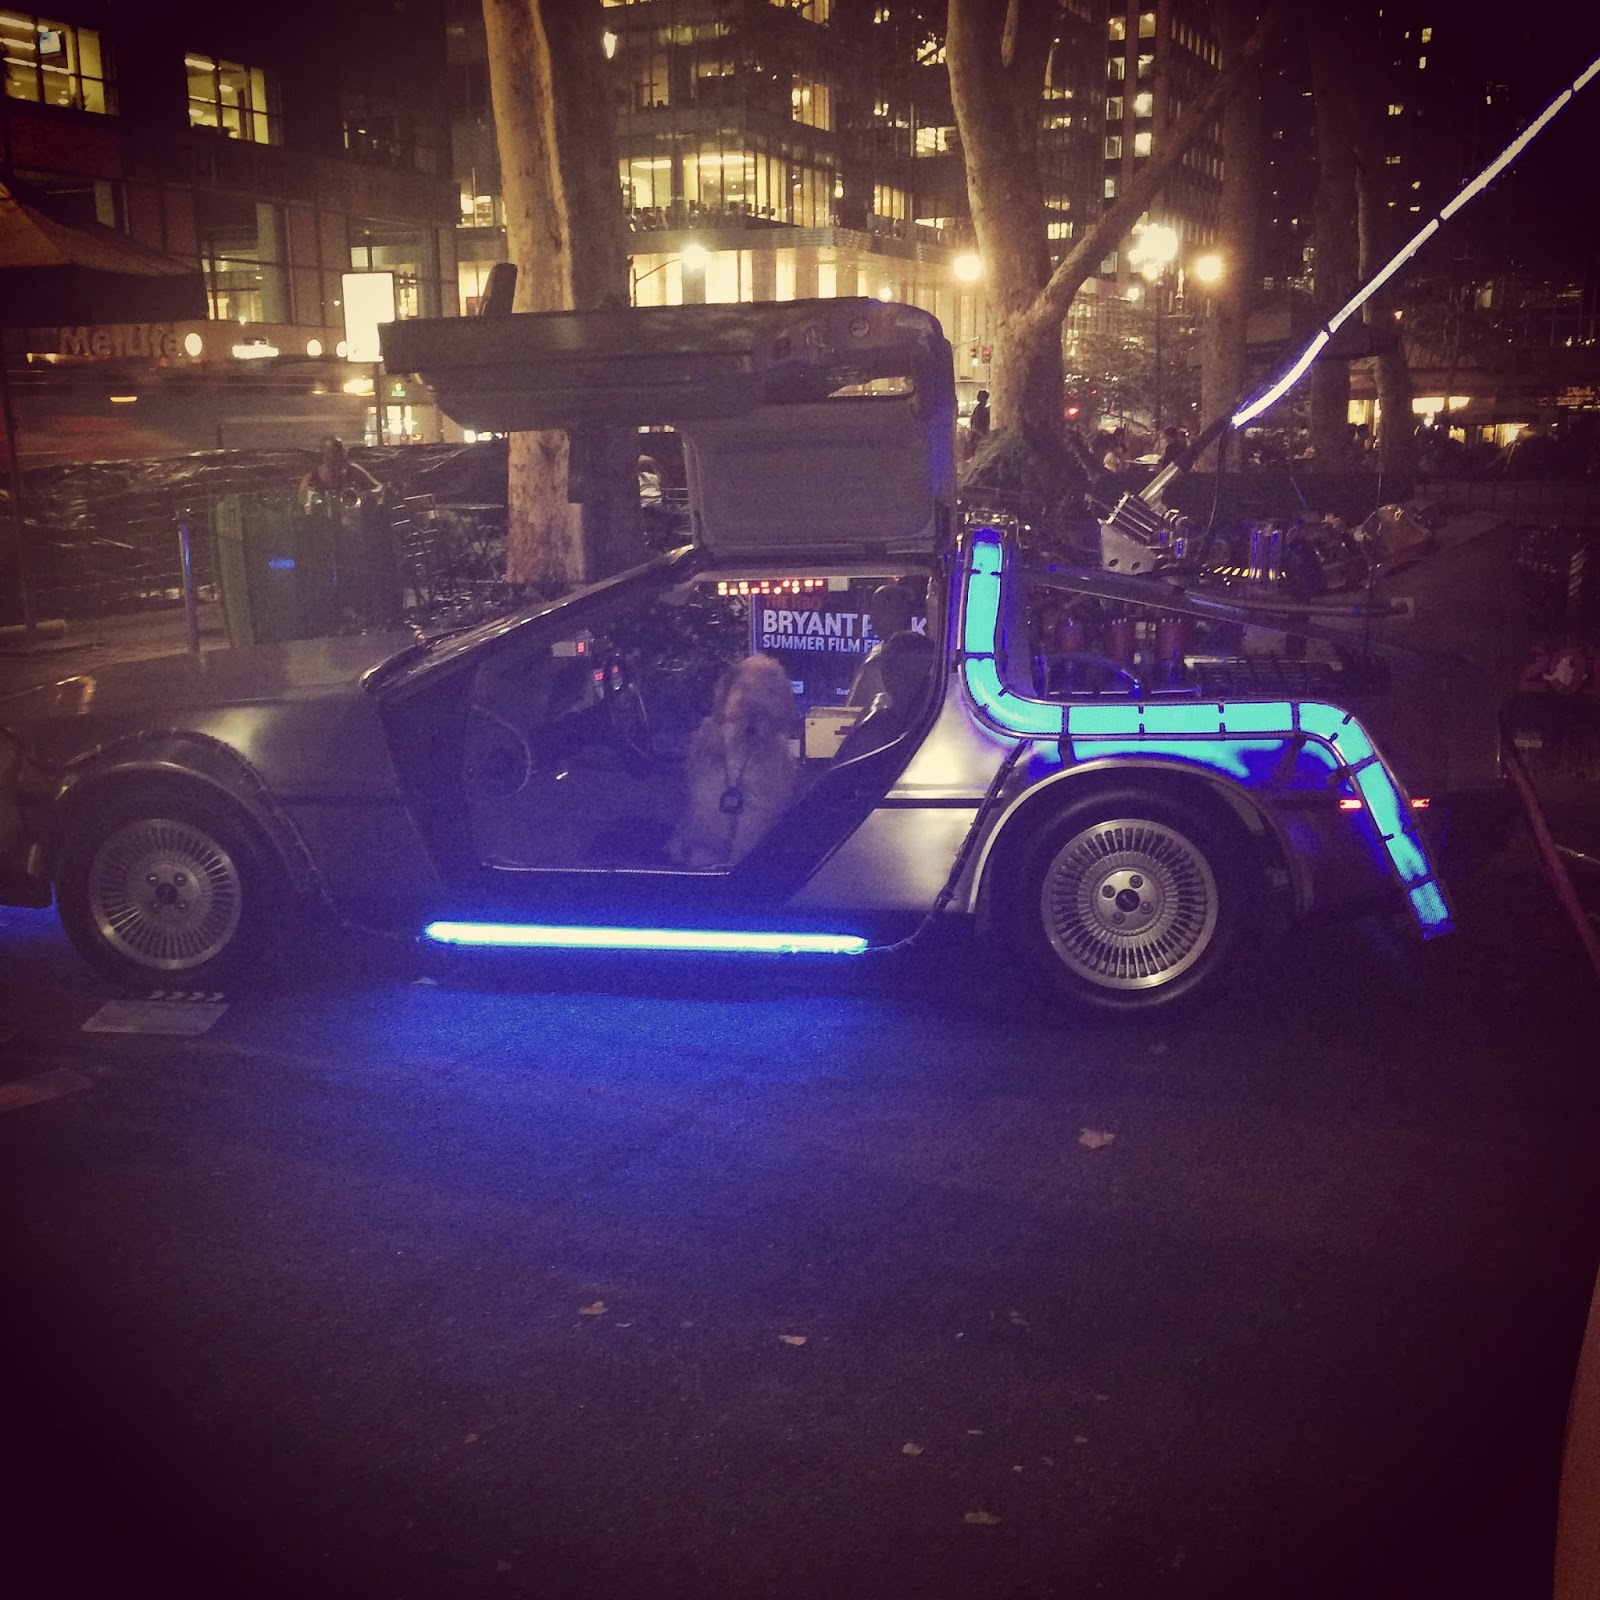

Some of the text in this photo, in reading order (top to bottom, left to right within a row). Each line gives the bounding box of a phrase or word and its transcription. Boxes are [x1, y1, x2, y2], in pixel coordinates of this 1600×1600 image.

[59, 324, 176, 357] MetLife
[763, 609, 927, 638] BRYANT PK
[763, 634, 825, 651] SUMMER
[828, 637, 860, 653] FILM
